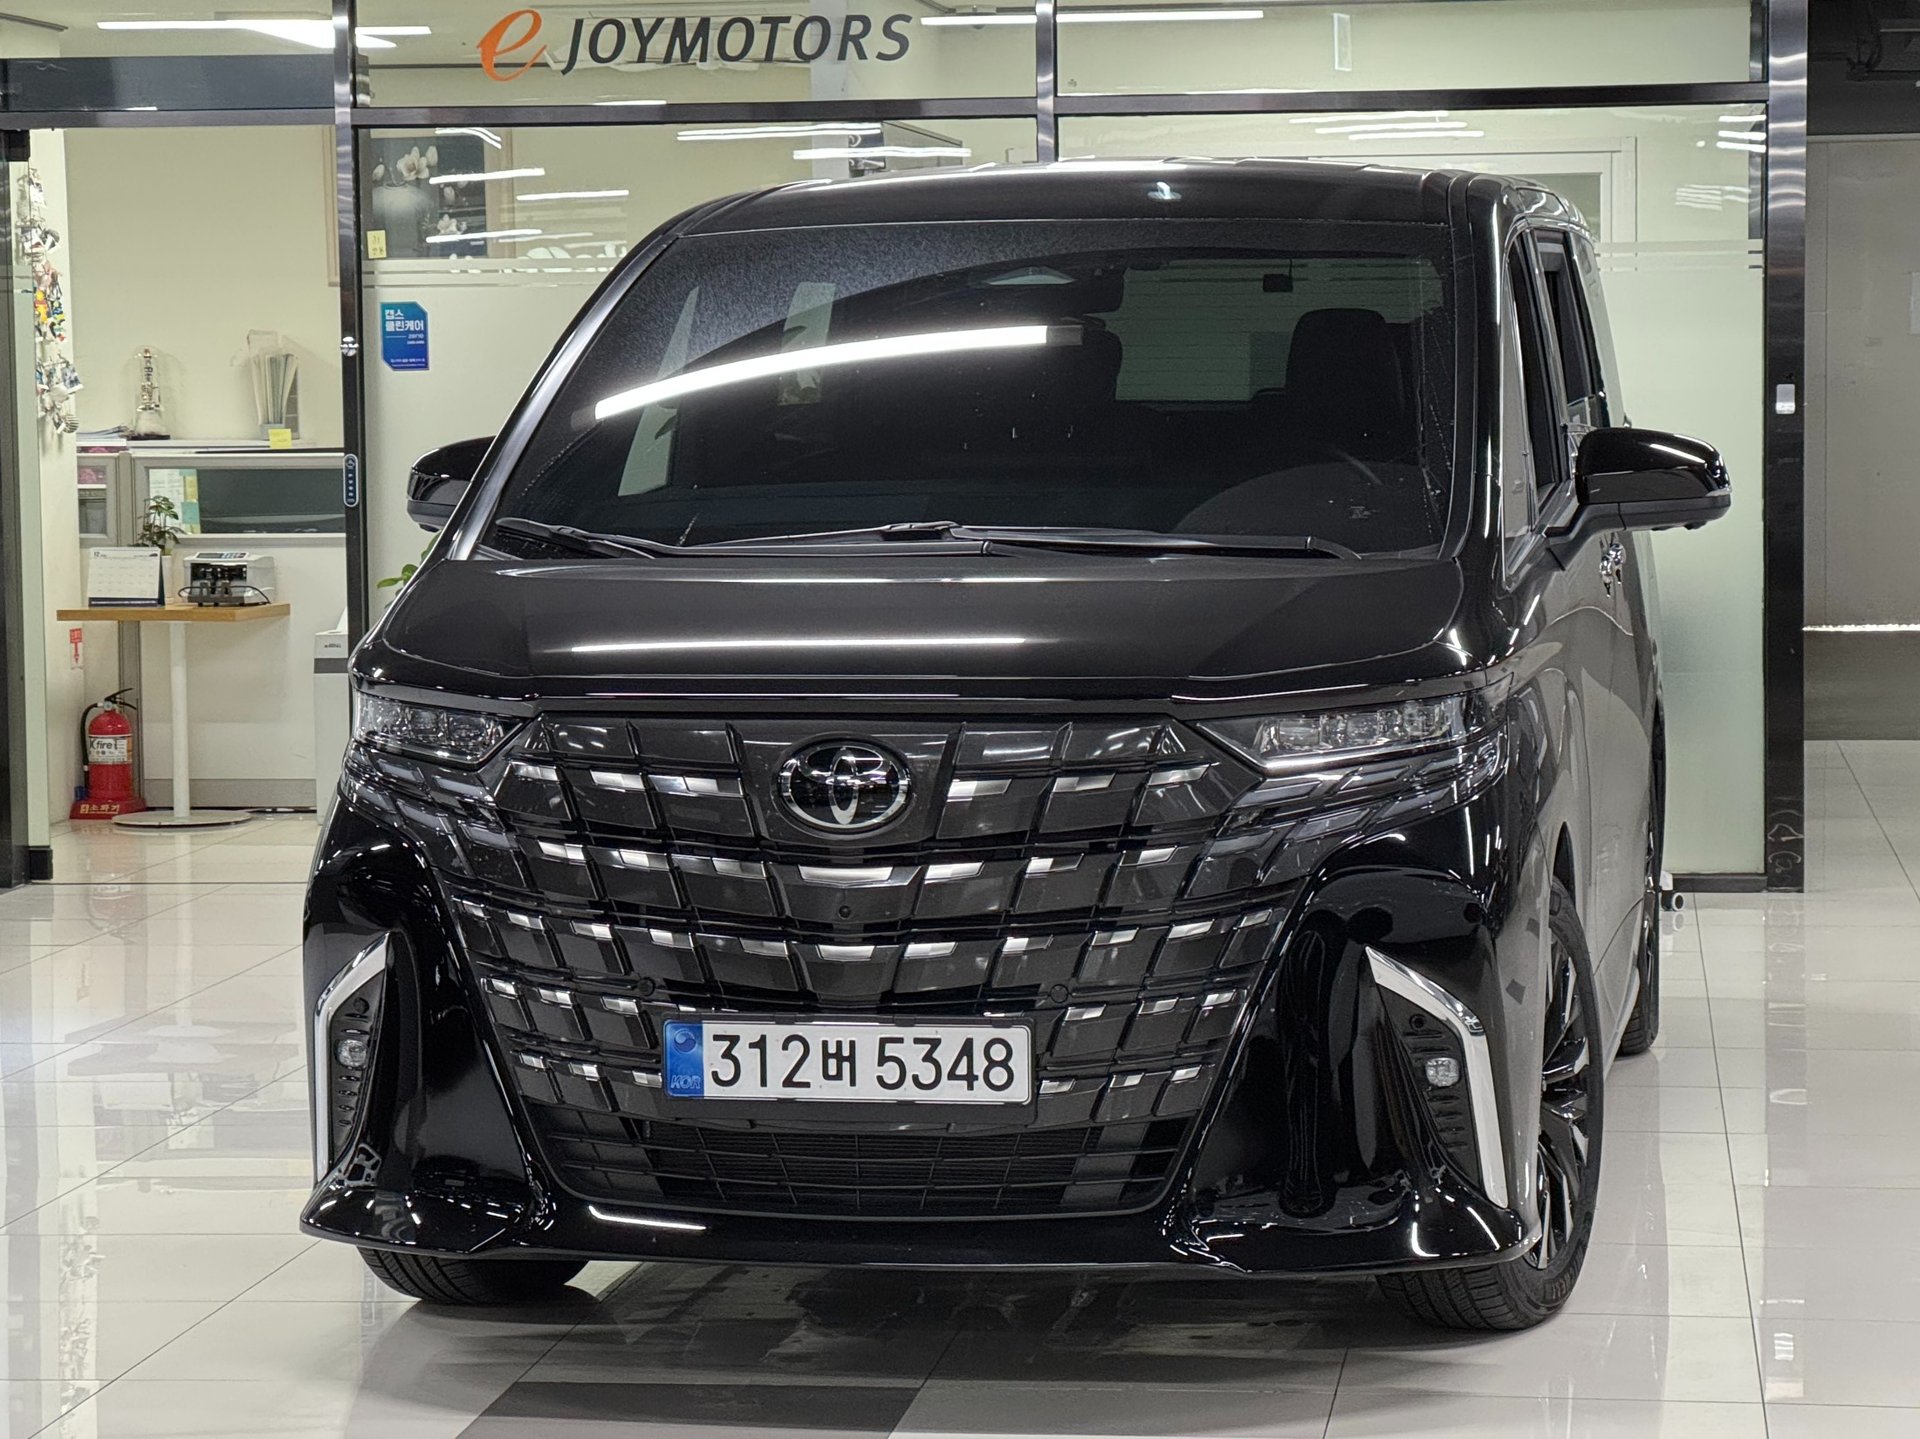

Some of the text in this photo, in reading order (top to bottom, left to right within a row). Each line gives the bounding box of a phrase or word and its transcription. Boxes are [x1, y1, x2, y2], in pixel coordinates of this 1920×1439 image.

[476, 8, 913, 82] e JOYMOTORS
[670, 1074, 702, 1089] KOR
[710, 1034, 1014, 1092] 312버 5348
